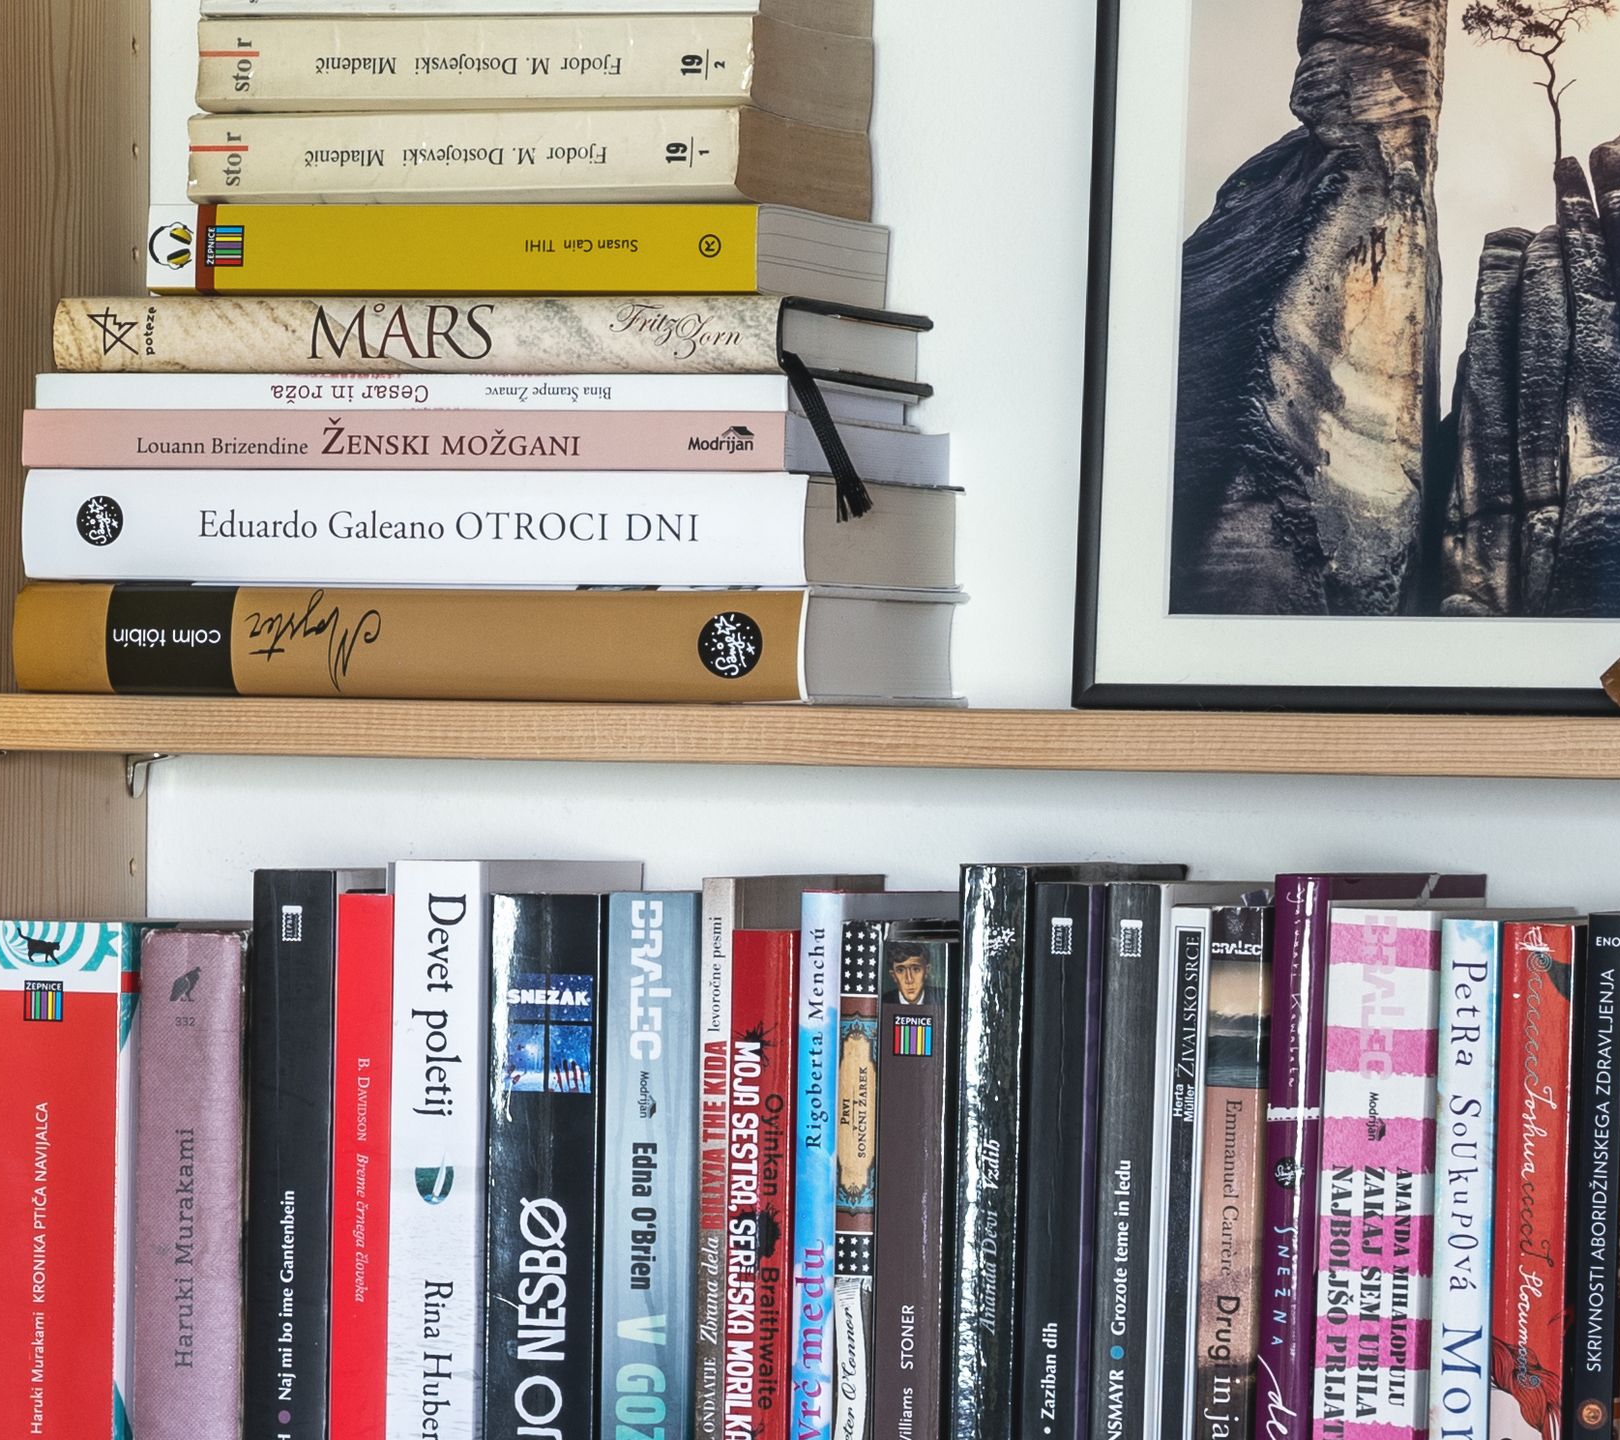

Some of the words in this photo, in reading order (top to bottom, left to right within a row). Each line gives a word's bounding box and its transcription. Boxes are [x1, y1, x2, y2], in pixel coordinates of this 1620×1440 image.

[315, 50, 397, 75] Mladenič
[414, 53, 518, 76] Dostojevski
[525, 57, 555, 76] M.
[561, 56, 623, 79] Fjodor
[524, 237, 555, 252] TIHI
[562, 237, 592, 254] Cain
[595, 239, 639, 254] Susan
[309, 301, 496, 362] MARS
[198, 509, 320, 541] Eduardo
[327, 509, 446, 547] Galeano
[455, 511, 611, 543] OTROCI
[627, 513, 698, 543] DNI
[112, 626, 168, 647] tóibín
[176, 628, 221, 645] colm
[428, 892, 468, 992] Devet
[412, 1008, 461, 1118] poletij
[34, 1101, 49, 1182] NAVIJALCA
[32, 1185, 47, 1230] PTIČA
[32, 1233, 46, 1303] KRONIKA
[518, 1196, 568, 1362] NESBØ
[424, 1278, 456, 1341] Rina
[616, 1313, 667, 1346] V
[31, 1311, 44, 1393] Murakami
[30, 1399, 43, 1434] Haruki
